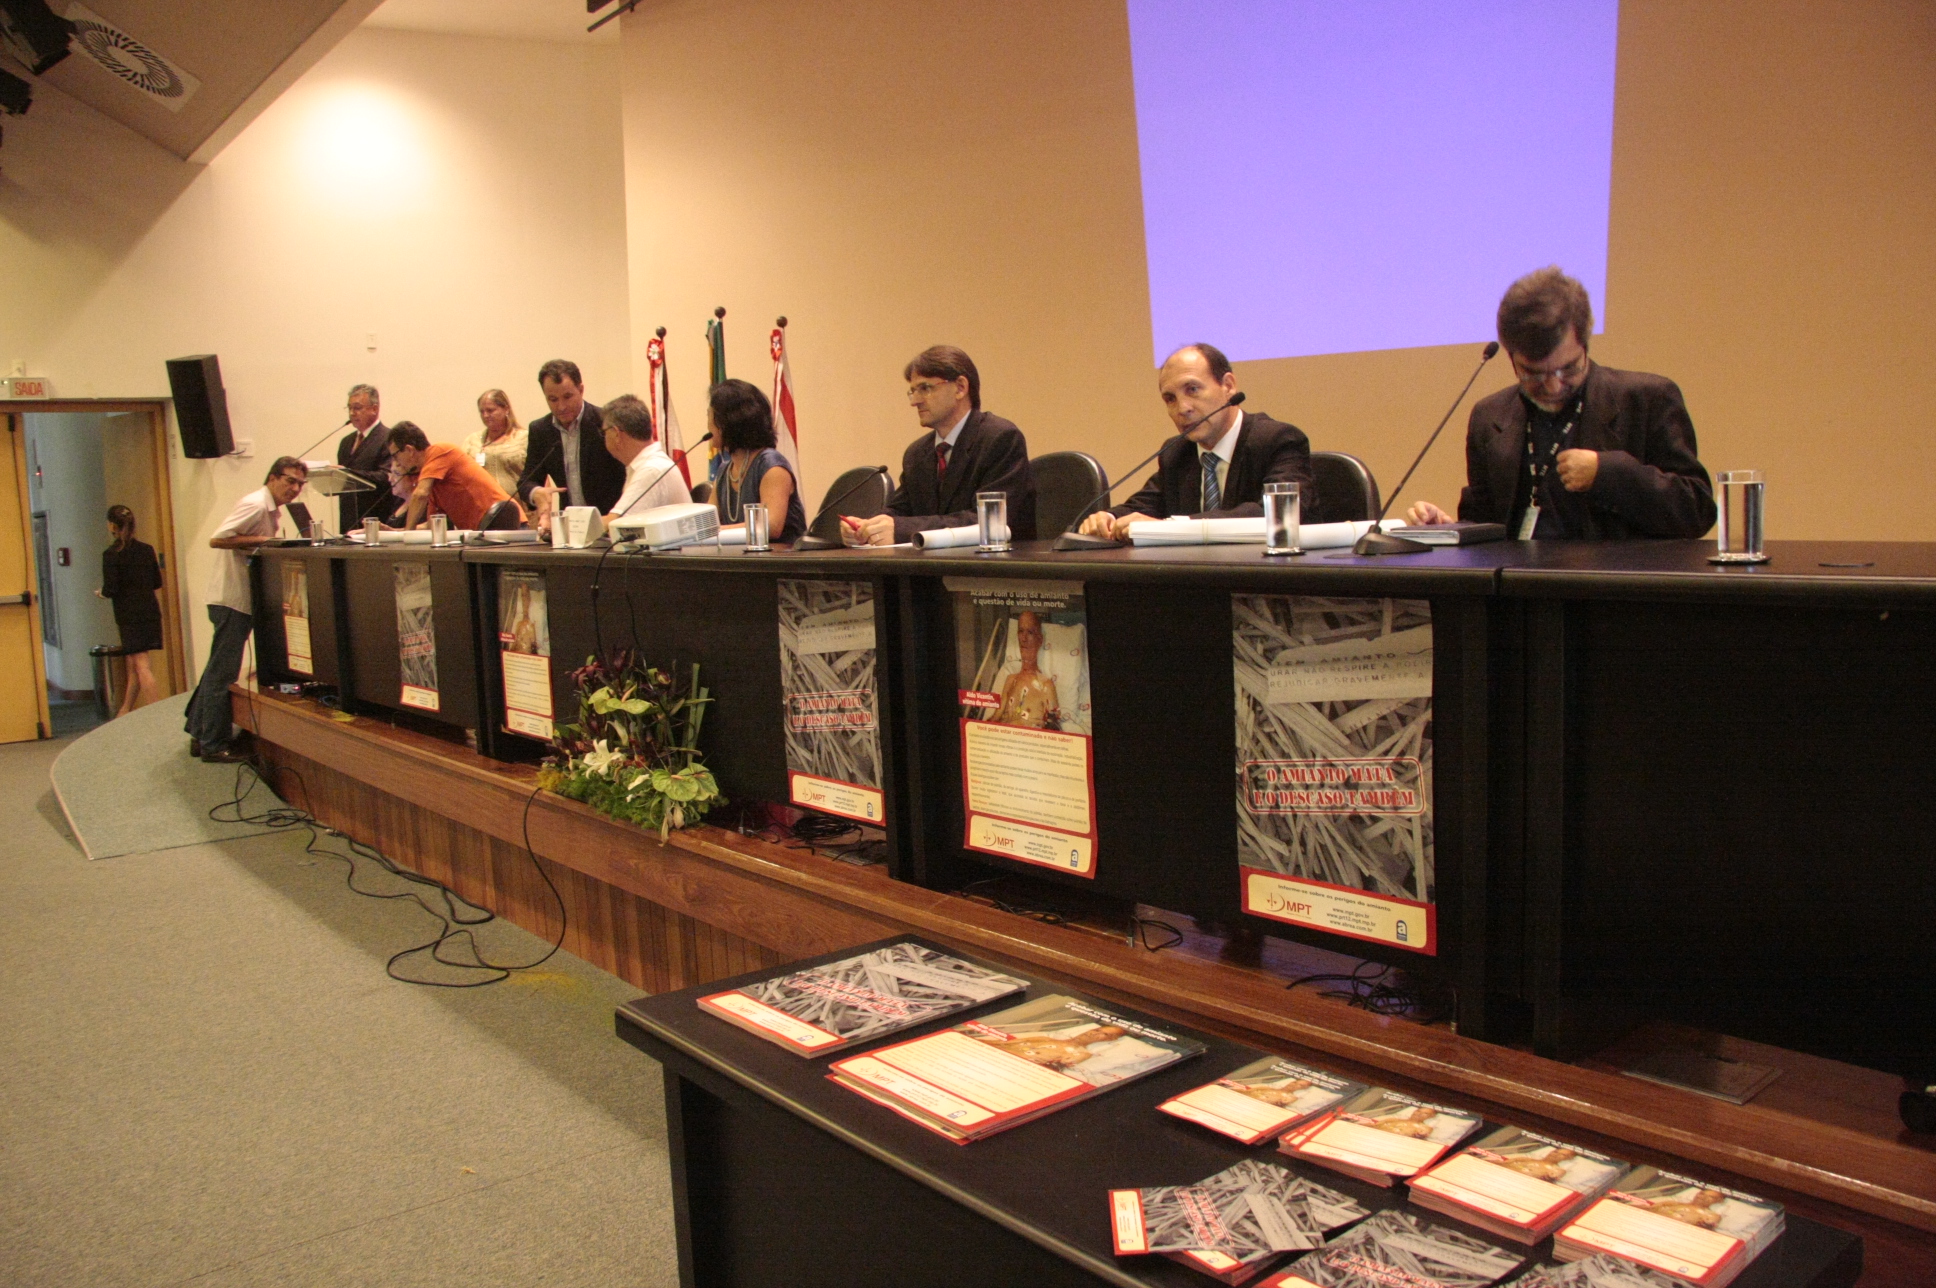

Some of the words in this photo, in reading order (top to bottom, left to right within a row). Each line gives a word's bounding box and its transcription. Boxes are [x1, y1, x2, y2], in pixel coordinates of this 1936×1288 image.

[1321, 652, 1396, 663] AMIANTO
[1330, 663, 1376, 672] RESPIRE
[1266, 767, 1277, 782] O
[1281, 767, 1347, 782] AMIANTO
[1350, 766, 1394, 782] MATA
[1253, 791, 1264, 805] E
[1265, 791, 1276, 805] O
[1279, 790, 1344, 805] DESCASO
[997, 836, 1014, 848] MPT
[1278, 884, 1308, 894] Informe-se
[1309, 889, 1325, 897] sobre
[1334, 895, 1356, 905] perigos
[1286, 900, 1312, 915] MPT
